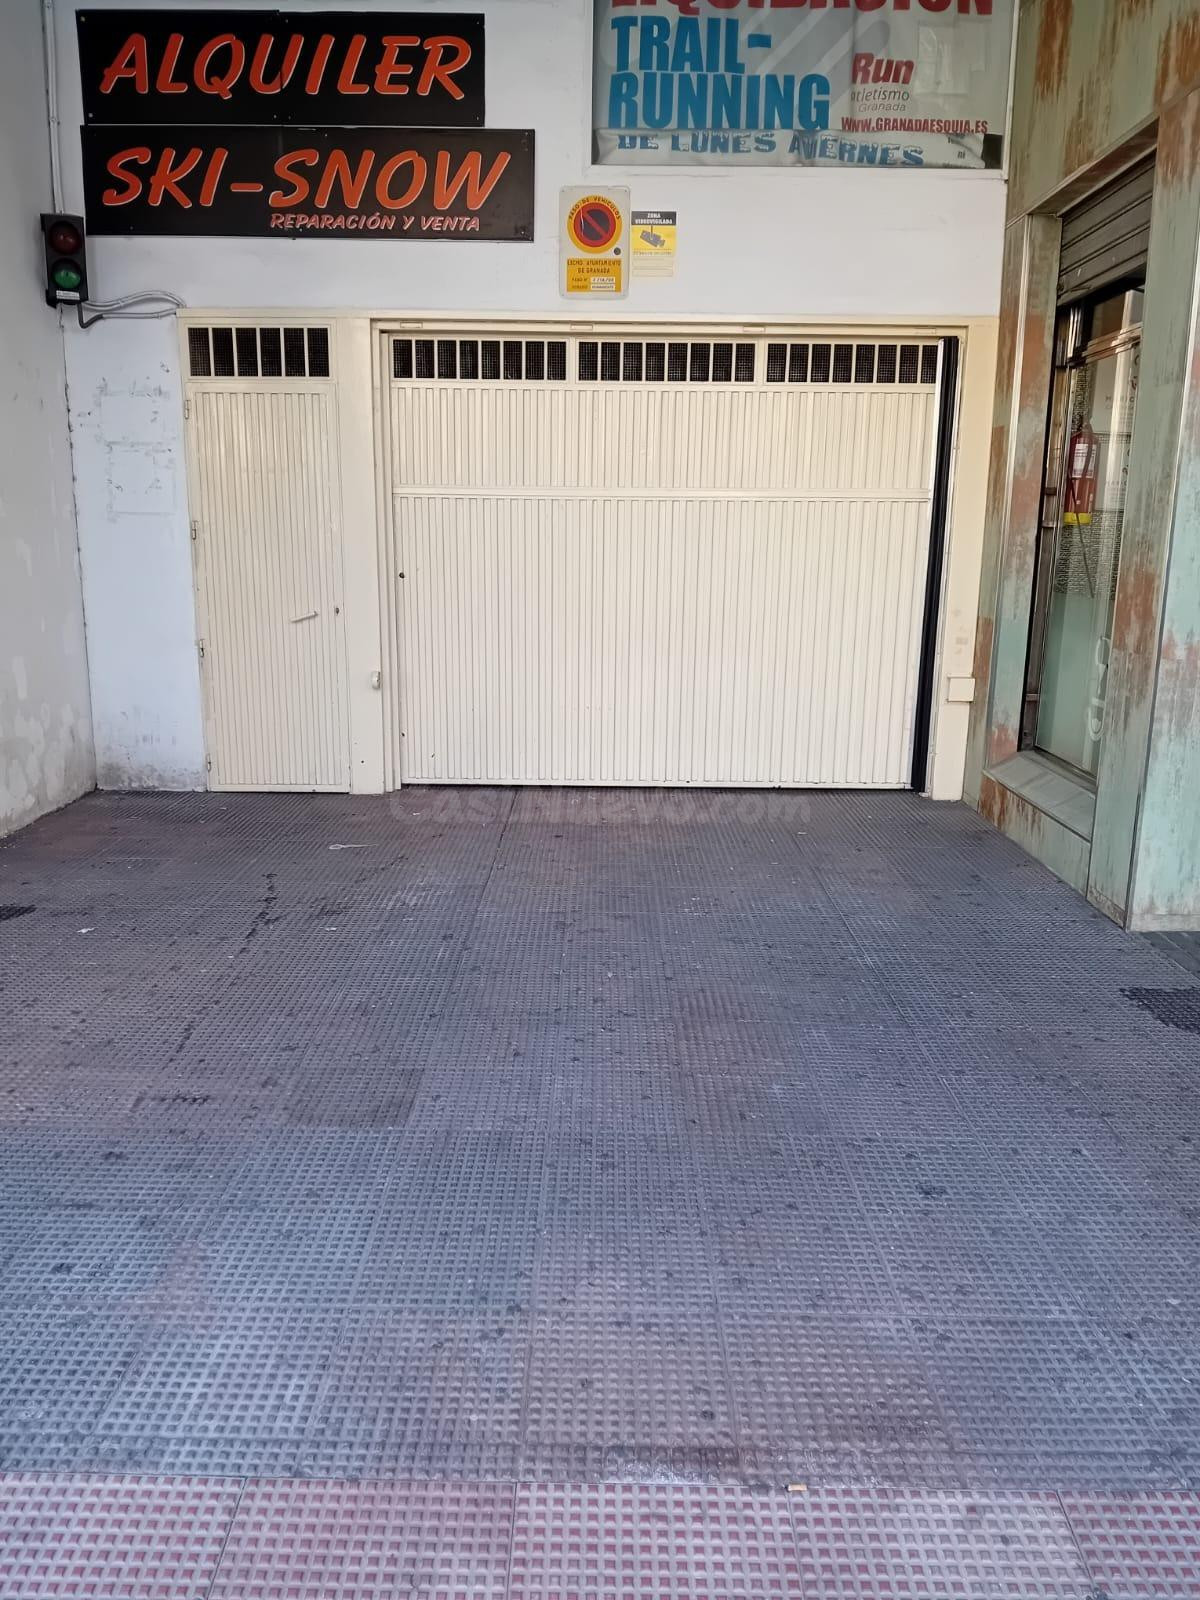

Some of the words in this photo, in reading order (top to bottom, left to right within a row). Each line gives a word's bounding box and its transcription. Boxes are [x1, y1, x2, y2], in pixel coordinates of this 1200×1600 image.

[100, 33, 471, 100] ALQUILER
[611, 16, 772, 73] TRAIL-
[852, 52, 914, 85] Run
[607, 72, 829, 129] RUNNING
[858, 102, 906, 112] Granada
[102, 147, 511, 210] SKI-SNOW
[270, 212, 394, 231] REPARACIÓN
[402, 215, 417, 231] Y
[419, 214, 480, 232] VENTA
